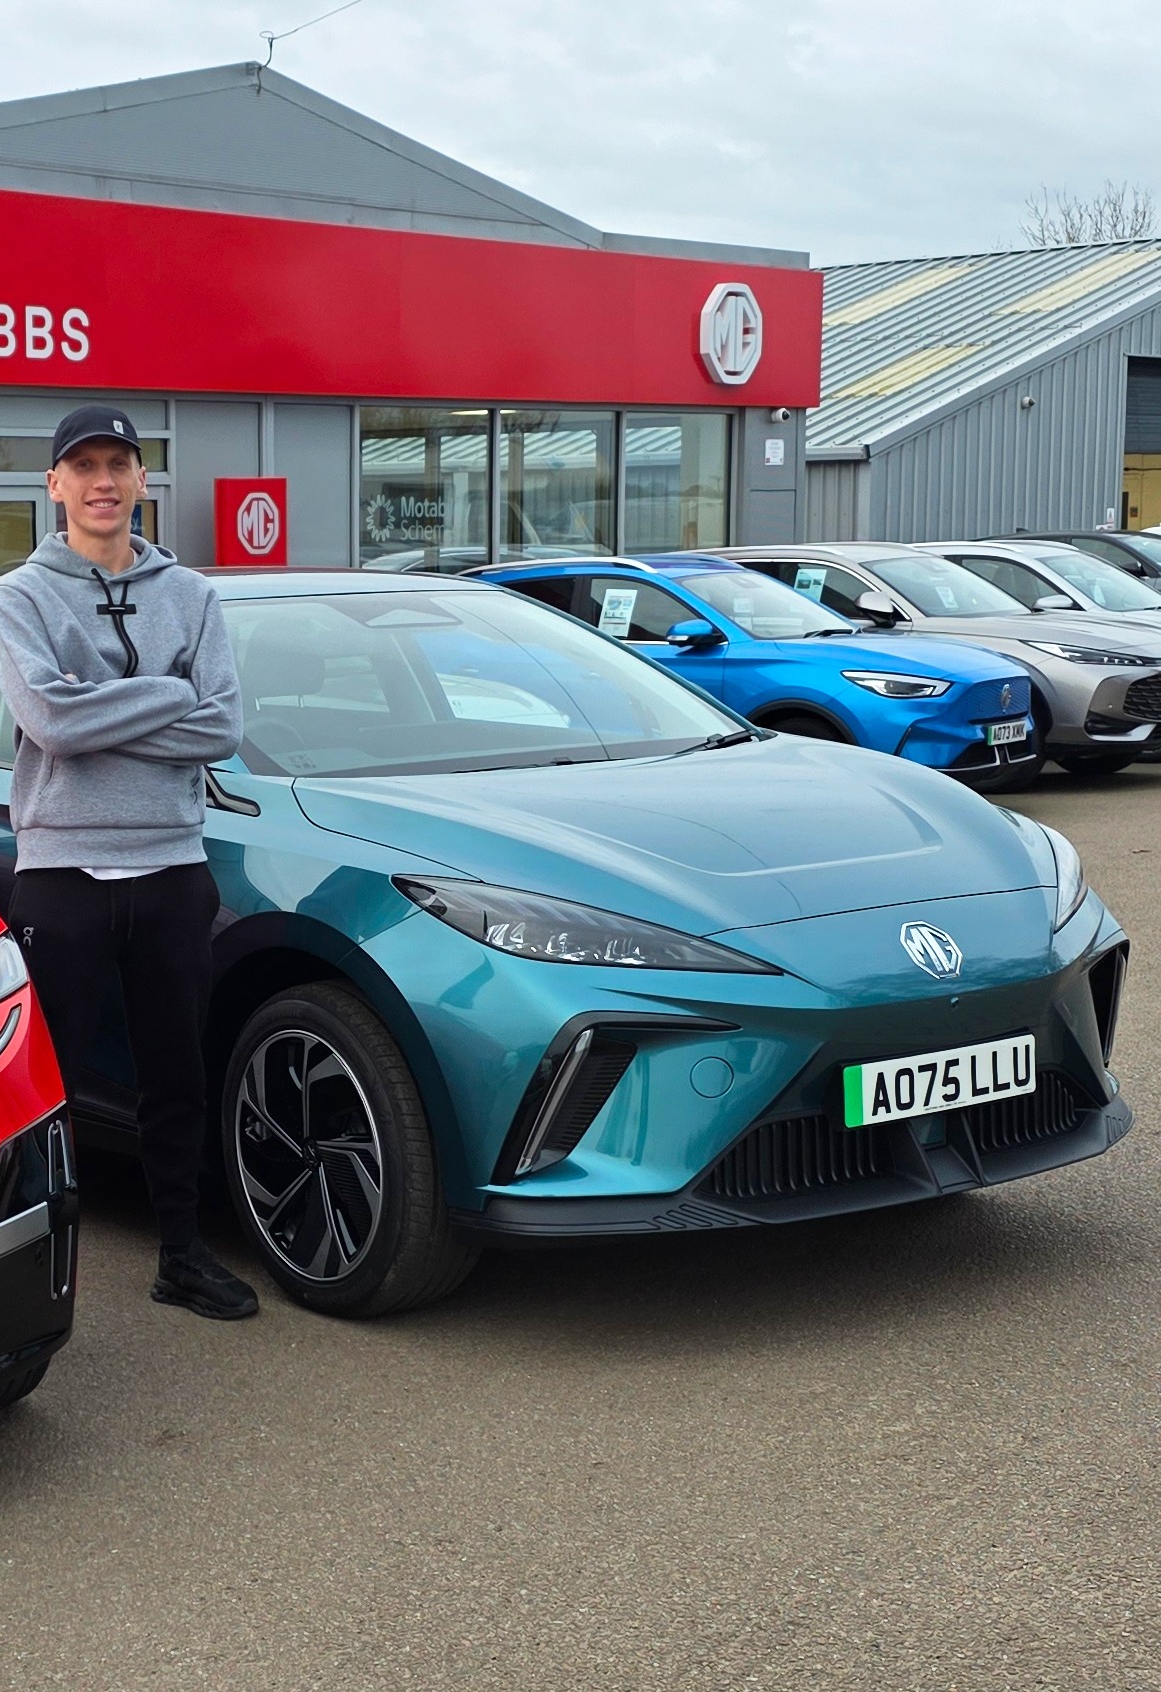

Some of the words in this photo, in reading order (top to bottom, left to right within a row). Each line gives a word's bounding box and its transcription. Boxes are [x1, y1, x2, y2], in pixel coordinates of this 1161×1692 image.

[713, 294, 758, 373] MG
[241, 499, 275, 548] MG
[905, 925, 959, 973] MG
[871, 1057, 961, 1117] AO75
[970, 1044, 1031, 1098] LLU
